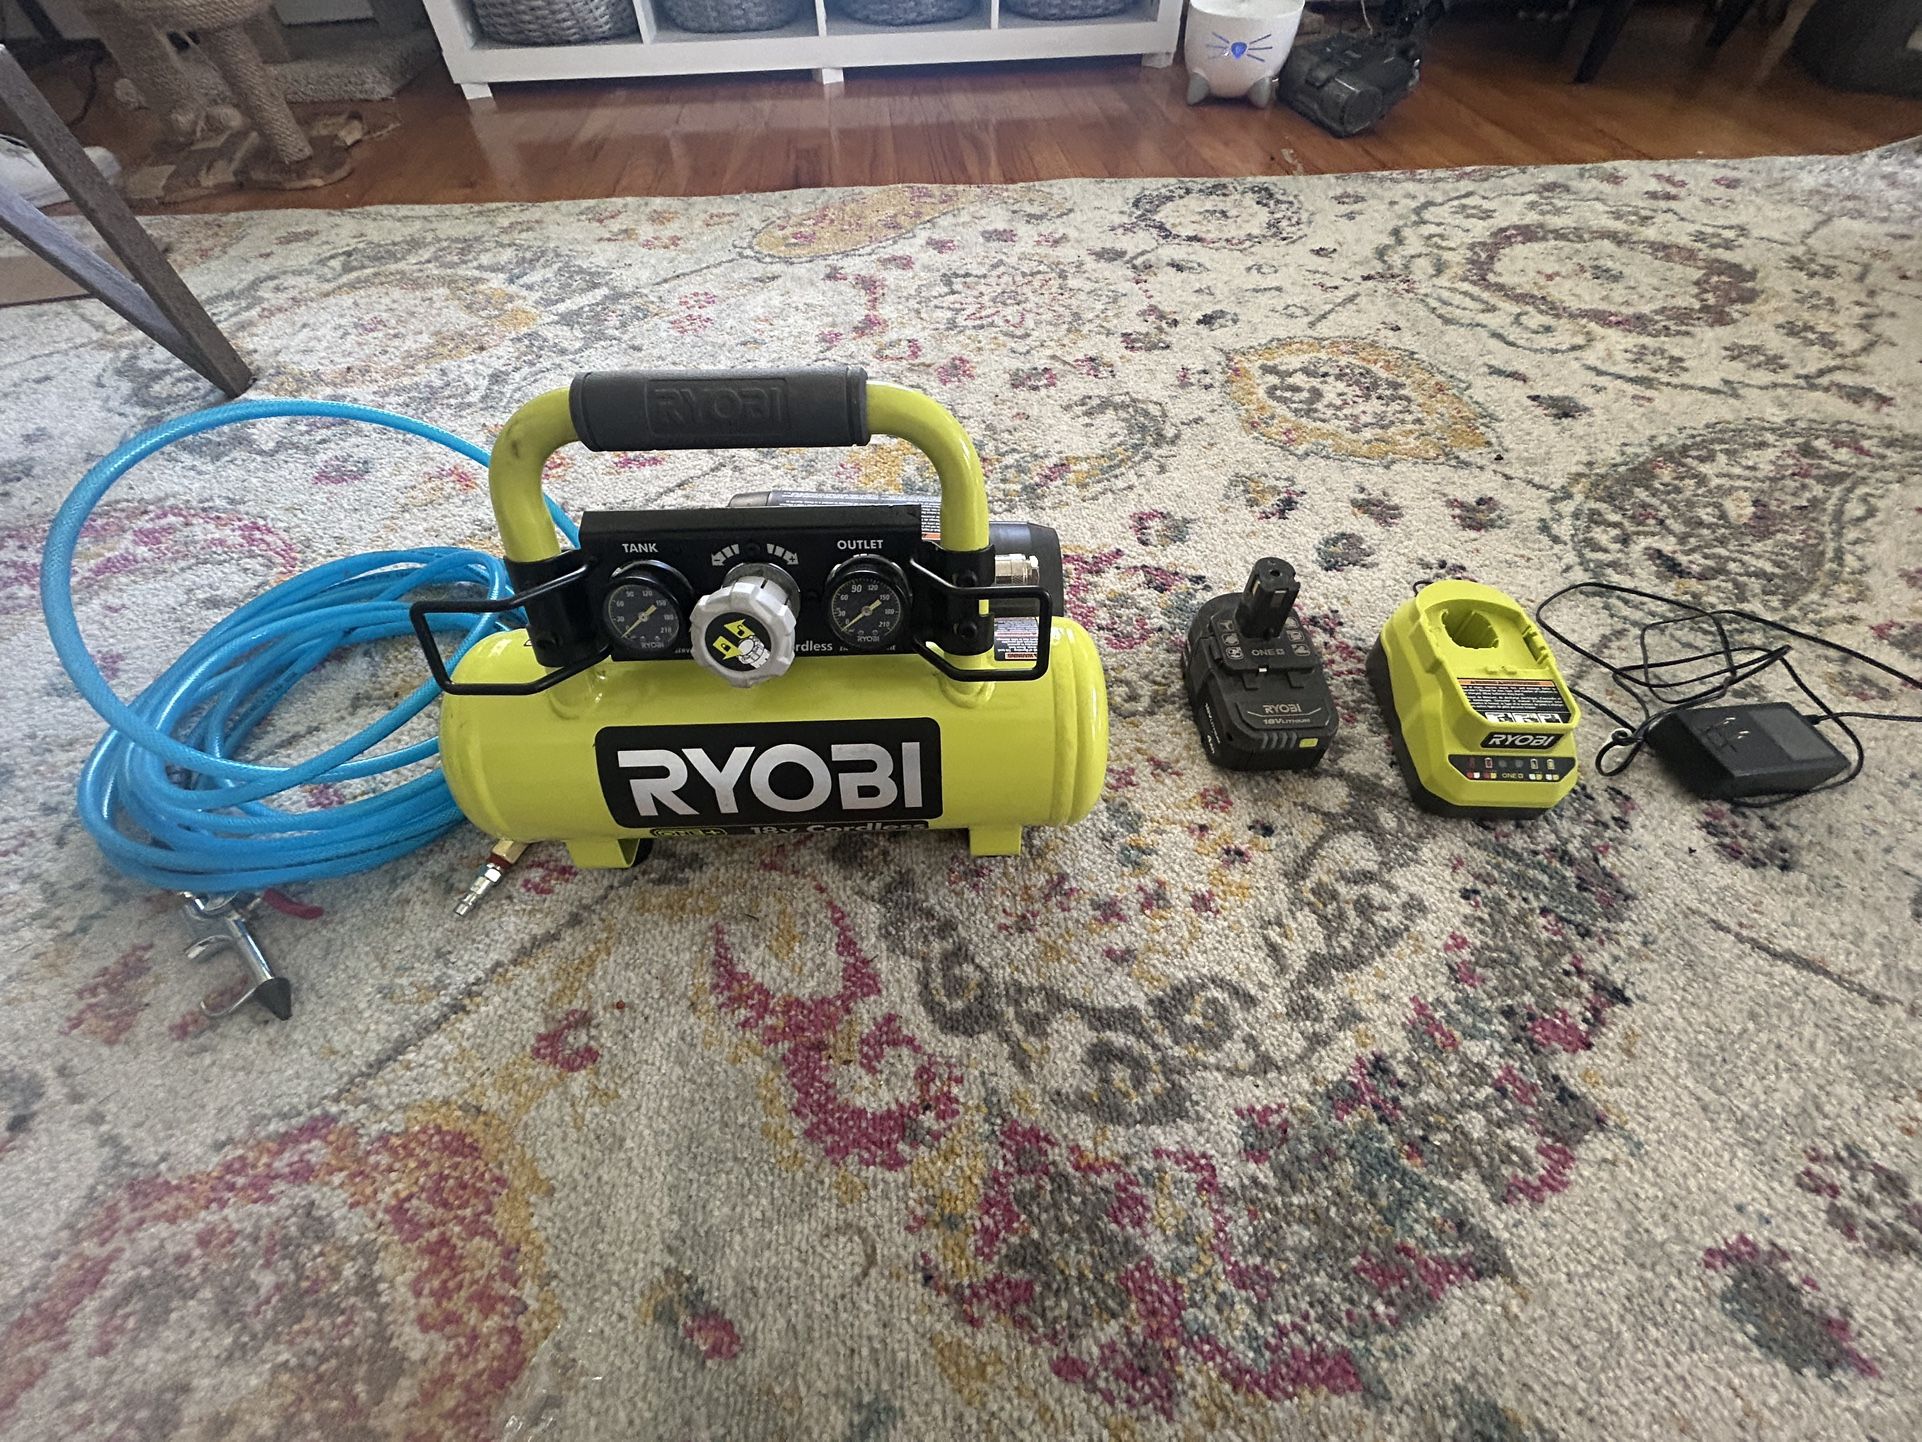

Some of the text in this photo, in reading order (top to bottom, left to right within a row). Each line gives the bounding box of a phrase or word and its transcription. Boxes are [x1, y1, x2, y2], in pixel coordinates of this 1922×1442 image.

[654, 386, 782, 423] RYOBI
[621, 543, 659, 553] TANK
[836, 539, 884, 550] OUTLET
[851, 584, 863, 593] 90
[795, 640, 833, 652] rdless
[1262, 703, 1302, 714] RYOBI
[1488, 734, 1555, 746] RYOBI
[617, 741, 923, 817] RYOBI
